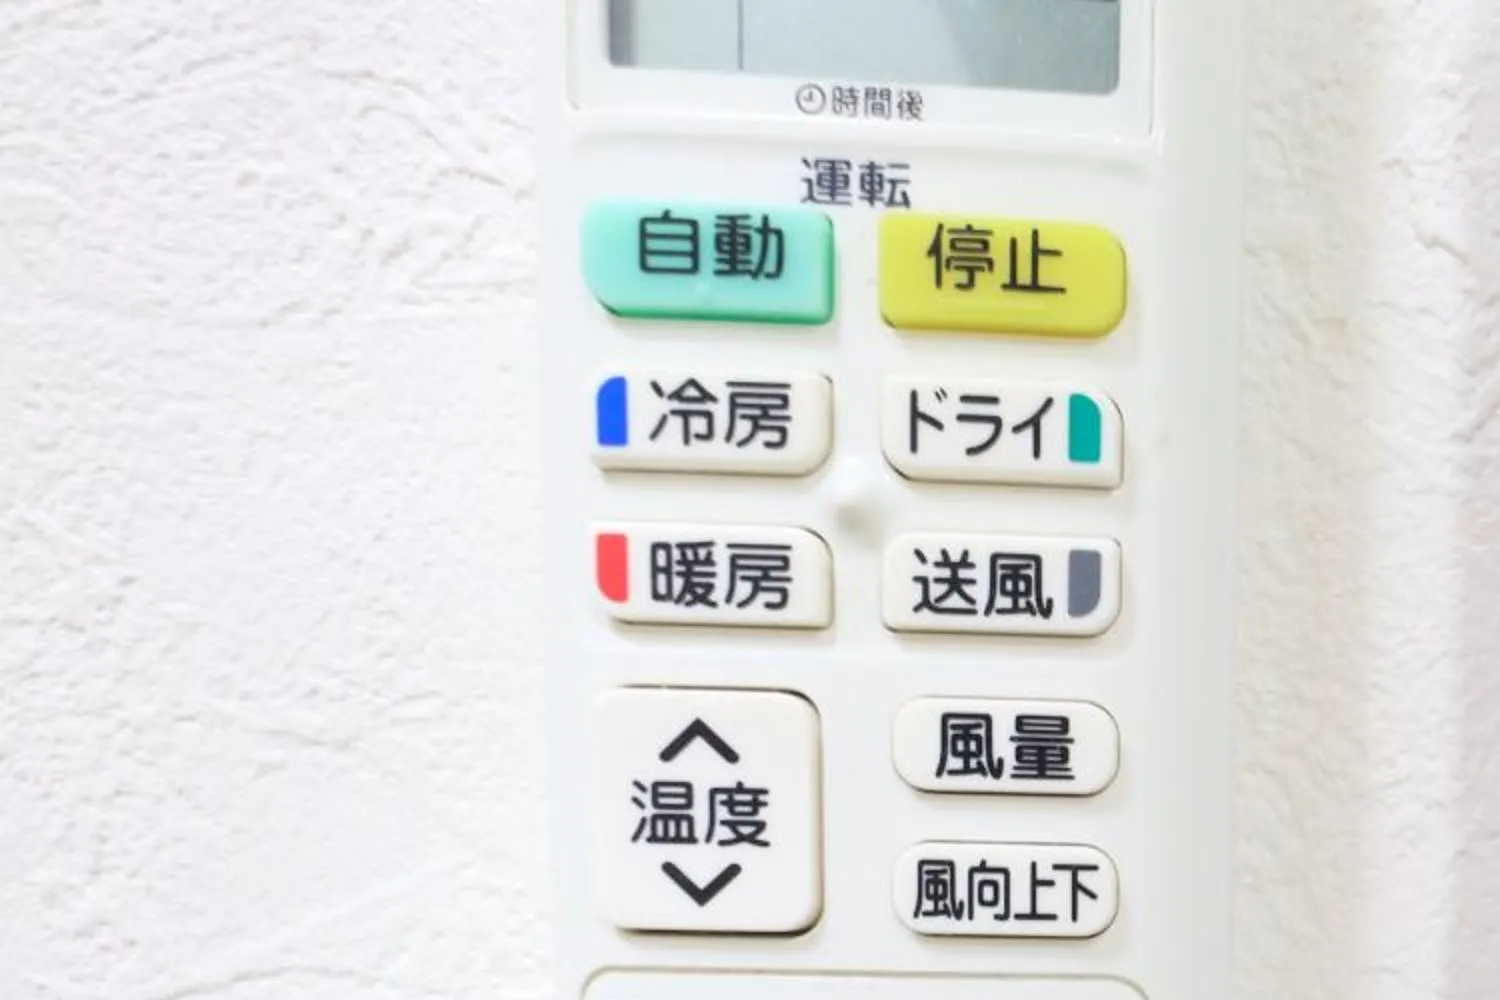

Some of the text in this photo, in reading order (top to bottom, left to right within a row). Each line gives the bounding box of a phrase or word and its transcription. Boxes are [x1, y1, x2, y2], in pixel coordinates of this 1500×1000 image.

[832, 86, 922, 119] 時間後
[802, 158, 910, 208] 運転
[639, 210, 784, 280] 自動
[927, 224, 1066, 294] 停止
[650, 378, 792, 449] 冷房
[910, 388, 1054, 459] ドライ
[651, 541, 792, 610] 暖房
[913, 549, 1053, 619] 送風
[936, 712, 1074, 780] 風量
[632, 781, 770, 847] 温度
[914, 859, 1099, 922] 風向上下
